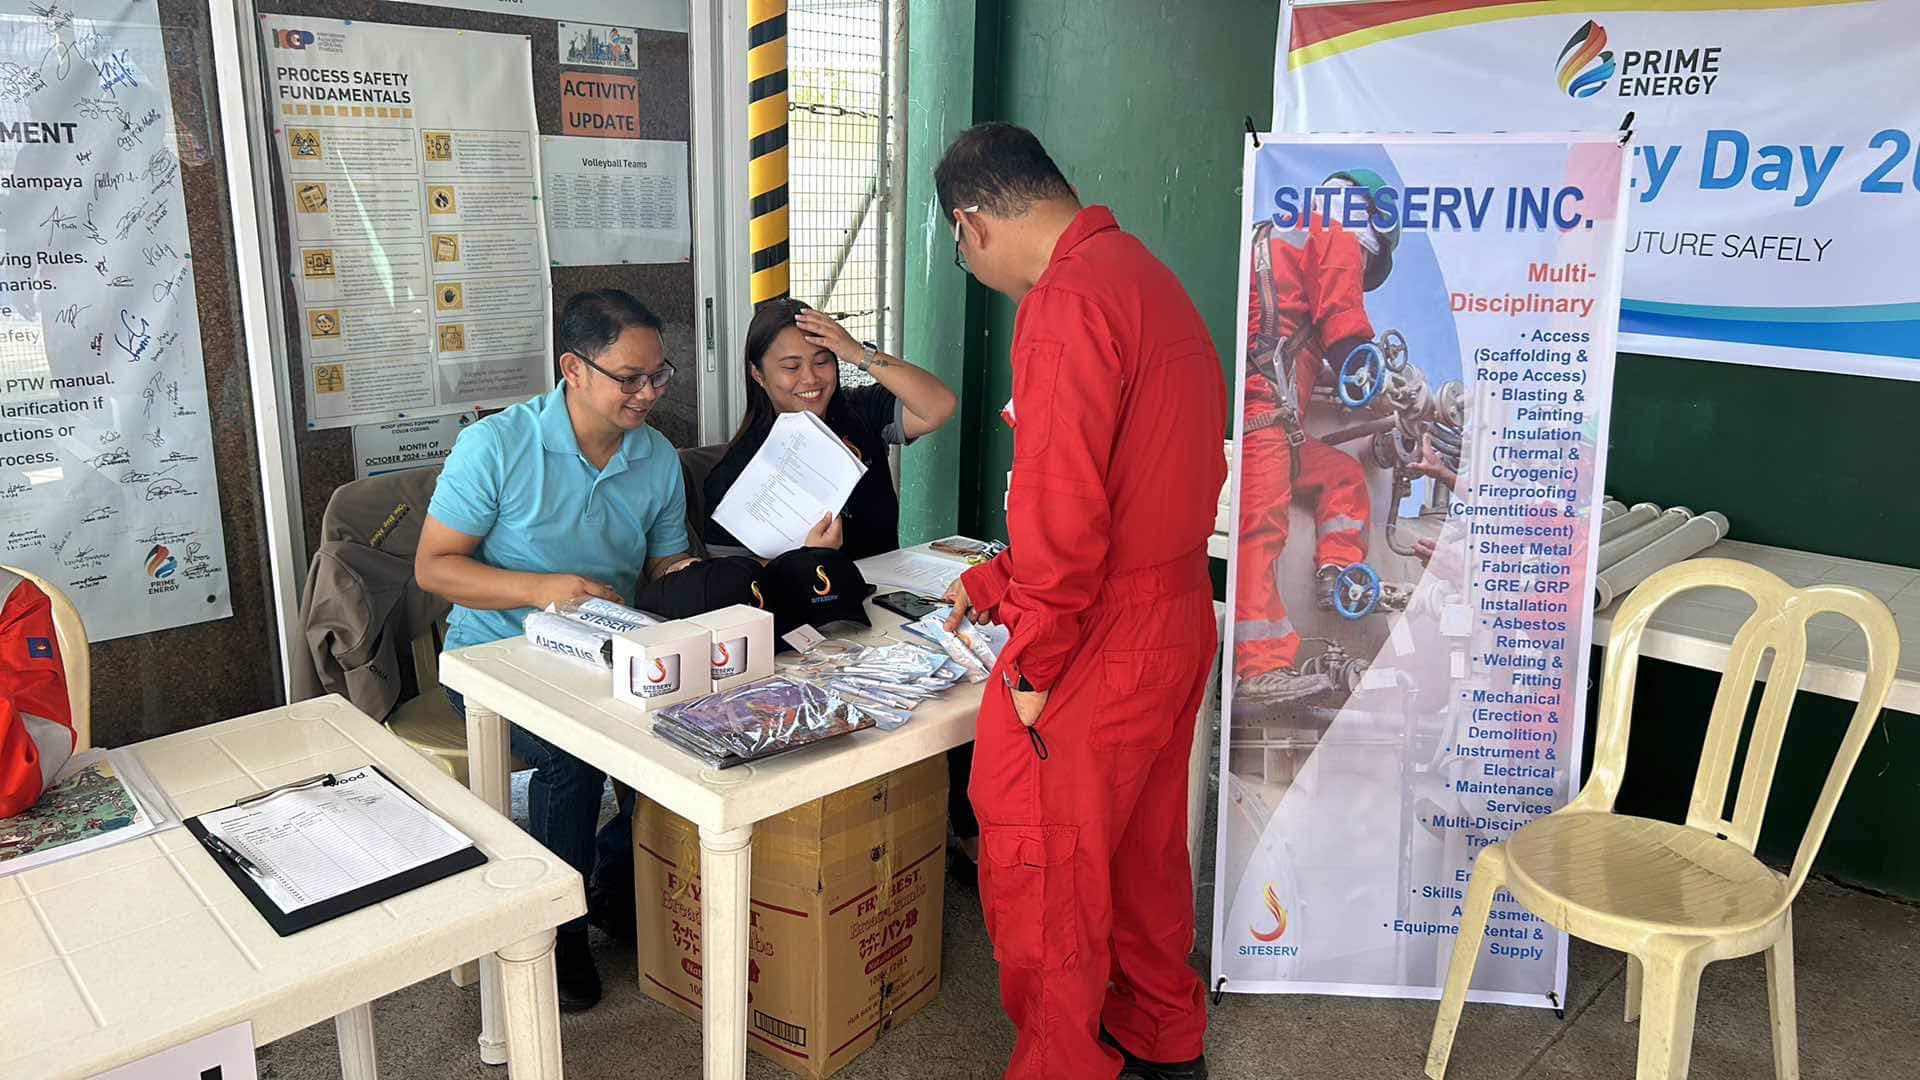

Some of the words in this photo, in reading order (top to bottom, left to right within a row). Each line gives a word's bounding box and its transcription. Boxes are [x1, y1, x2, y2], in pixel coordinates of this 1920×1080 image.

[1621, 47, 1722, 75] PRIME
[277, 67, 350, 84] PROCESS
[354, 71, 409, 86] SAFETY
[564, 80, 636, 100] ACTIVITY
[1618, 75, 1718, 97] ENERGY
[280, 85, 411, 104] FUNDAMENTALS
[569, 112, 634, 131] UPDATE
[0, 122, 77, 144] MENT
[582, 158, 622, 168] Volleyball
[623, 159, 648, 169] Teams
[1699, 129, 1844, 207] Day
[1860, 129, 1920, 194] 2
[1, 174, 83, 191] alampaya
[1272, 187, 1494, 229] SITESERV
[1506, 187, 1593, 229] INC.
[1721, 234, 1833, 262] SAFELY
[37, 251, 88, 266] Rules.
[1528, 263, 1596, 282] Multi-
[0, 277, 57, 292] narios.
[1450, 293, 1594, 318] Disciplinary
[1531, 329, 1590, 343] Access
[1474, 349, 1571, 365] (Scaffolding
[1577, 350, 1588, 362] &
[6, 377, 44, 393] PTW
[50, 372, 115, 388] manual.
[1477, 369, 1518, 384] Rope
[1522, 369, 1587, 384] Access)
[1502, 389, 1568, 404] Blasting
[1573, 389, 1585, 402] &
[1, 400, 89, 417] larification
[93, 396, 104, 410] if
[1517, 408, 1584, 424] Painting
[58, 425, 76, 437] or
[1503, 428, 1581, 441] Insulation
[399, 441, 427, 452] MONTH
[429, 441, 439, 449] OF
[1492, 446, 1562, 461] (Thermal
[1568, 448, 1580, 460] &
[365, 455, 401, 465] OCTOBER
[403, 453, 419, 462] 2024
[1492, 466, 1578, 482] Cryogenic)
[1479, 485, 1577, 501] Fireproofing
[1449, 503, 1558, 518] (Cementitious
[1564, 506, 1576, 517] &
[1471, 522, 1573, 538] Intumescent)
[1479, 542, 1524, 555] Sheet
[1530, 543, 1572, 556] Metal
[1481, 560, 1570, 574] Fabrication
[148, 584, 180, 595] ENERGY
[150, 579, 176, 588] PRIME
[1484, 580, 1520, 592] GRE
[1524, 581, 1530, 593] /
[1534, 581, 1570, 593] GRP
[1481, 599, 1568, 613] Installation
[1492, 617, 1566, 631] Asbestos
[1496, 636, 1565, 650] Removal
[1484, 654, 1547, 670] Welding
[1552, 656, 1563, 669] &
[1512, 674, 1561, 690] Fitting
[1473, 690, 1560, 705] Mechanical
[1472, 709, 1542, 723] (Erection
[1548, 711, 1559, 723] &
[1468, 727, 1557, 744] Demolition)
[1456, 744, 1540, 759] Instrument
[1545, 748, 1556, 760] &
[1484, 763, 1555, 778] Electrical
[1456, 780, 1553, 796] Maintenance
[1487, 800, 1552, 814] Services
[1432, 816, 1532, 831] Multi-Discip
[1465, 835, 1504, 847] Trad
[1422, 886, 1463, 899] Skills
[1393, 920, 1459, 936] Equipme
[1533, 928, 1544, 940] &
[1239, 945, 1298, 956] SITESERV
[1490, 943, 1543, 960] Supply
